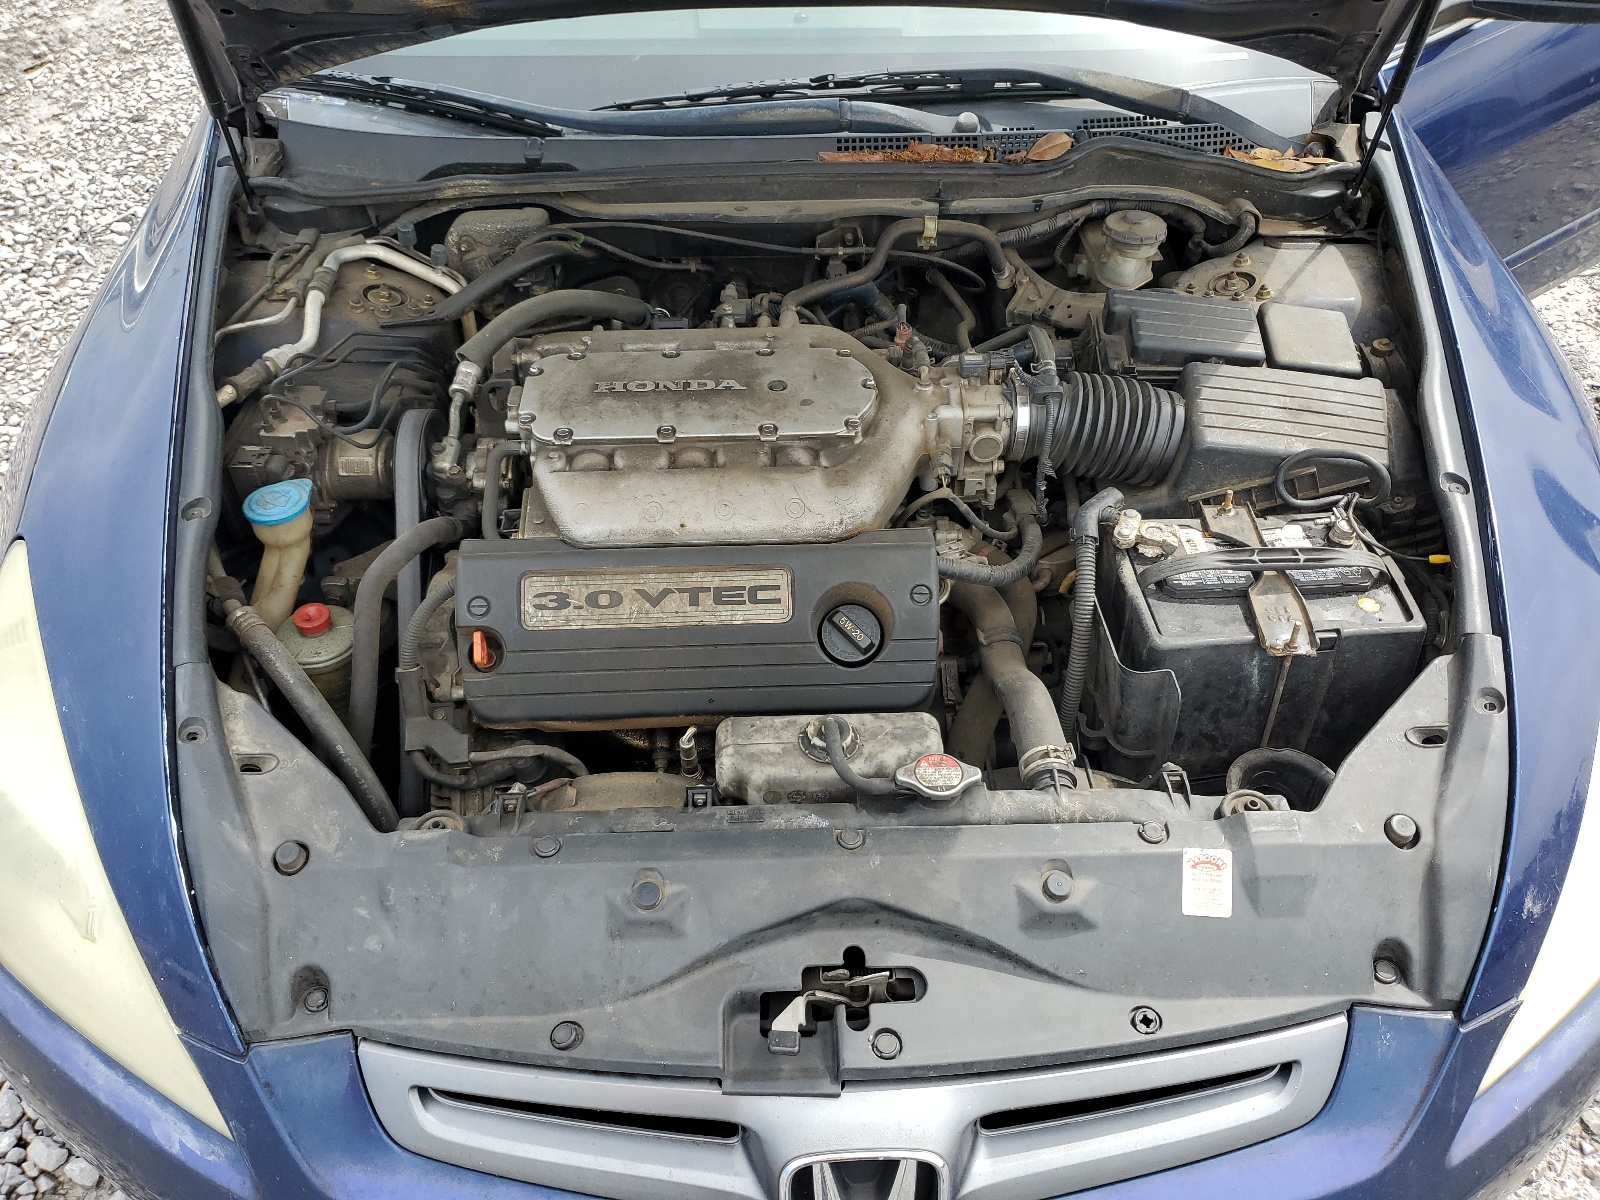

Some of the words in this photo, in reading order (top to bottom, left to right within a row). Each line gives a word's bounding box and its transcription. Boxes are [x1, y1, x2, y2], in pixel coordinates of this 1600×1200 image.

[594, 379, 747, 393] HONDA
[532, 589, 624, 611] 3.0
[633, 585, 782, 609] VTEC
[839, 616, 864, 641] 5W-20
